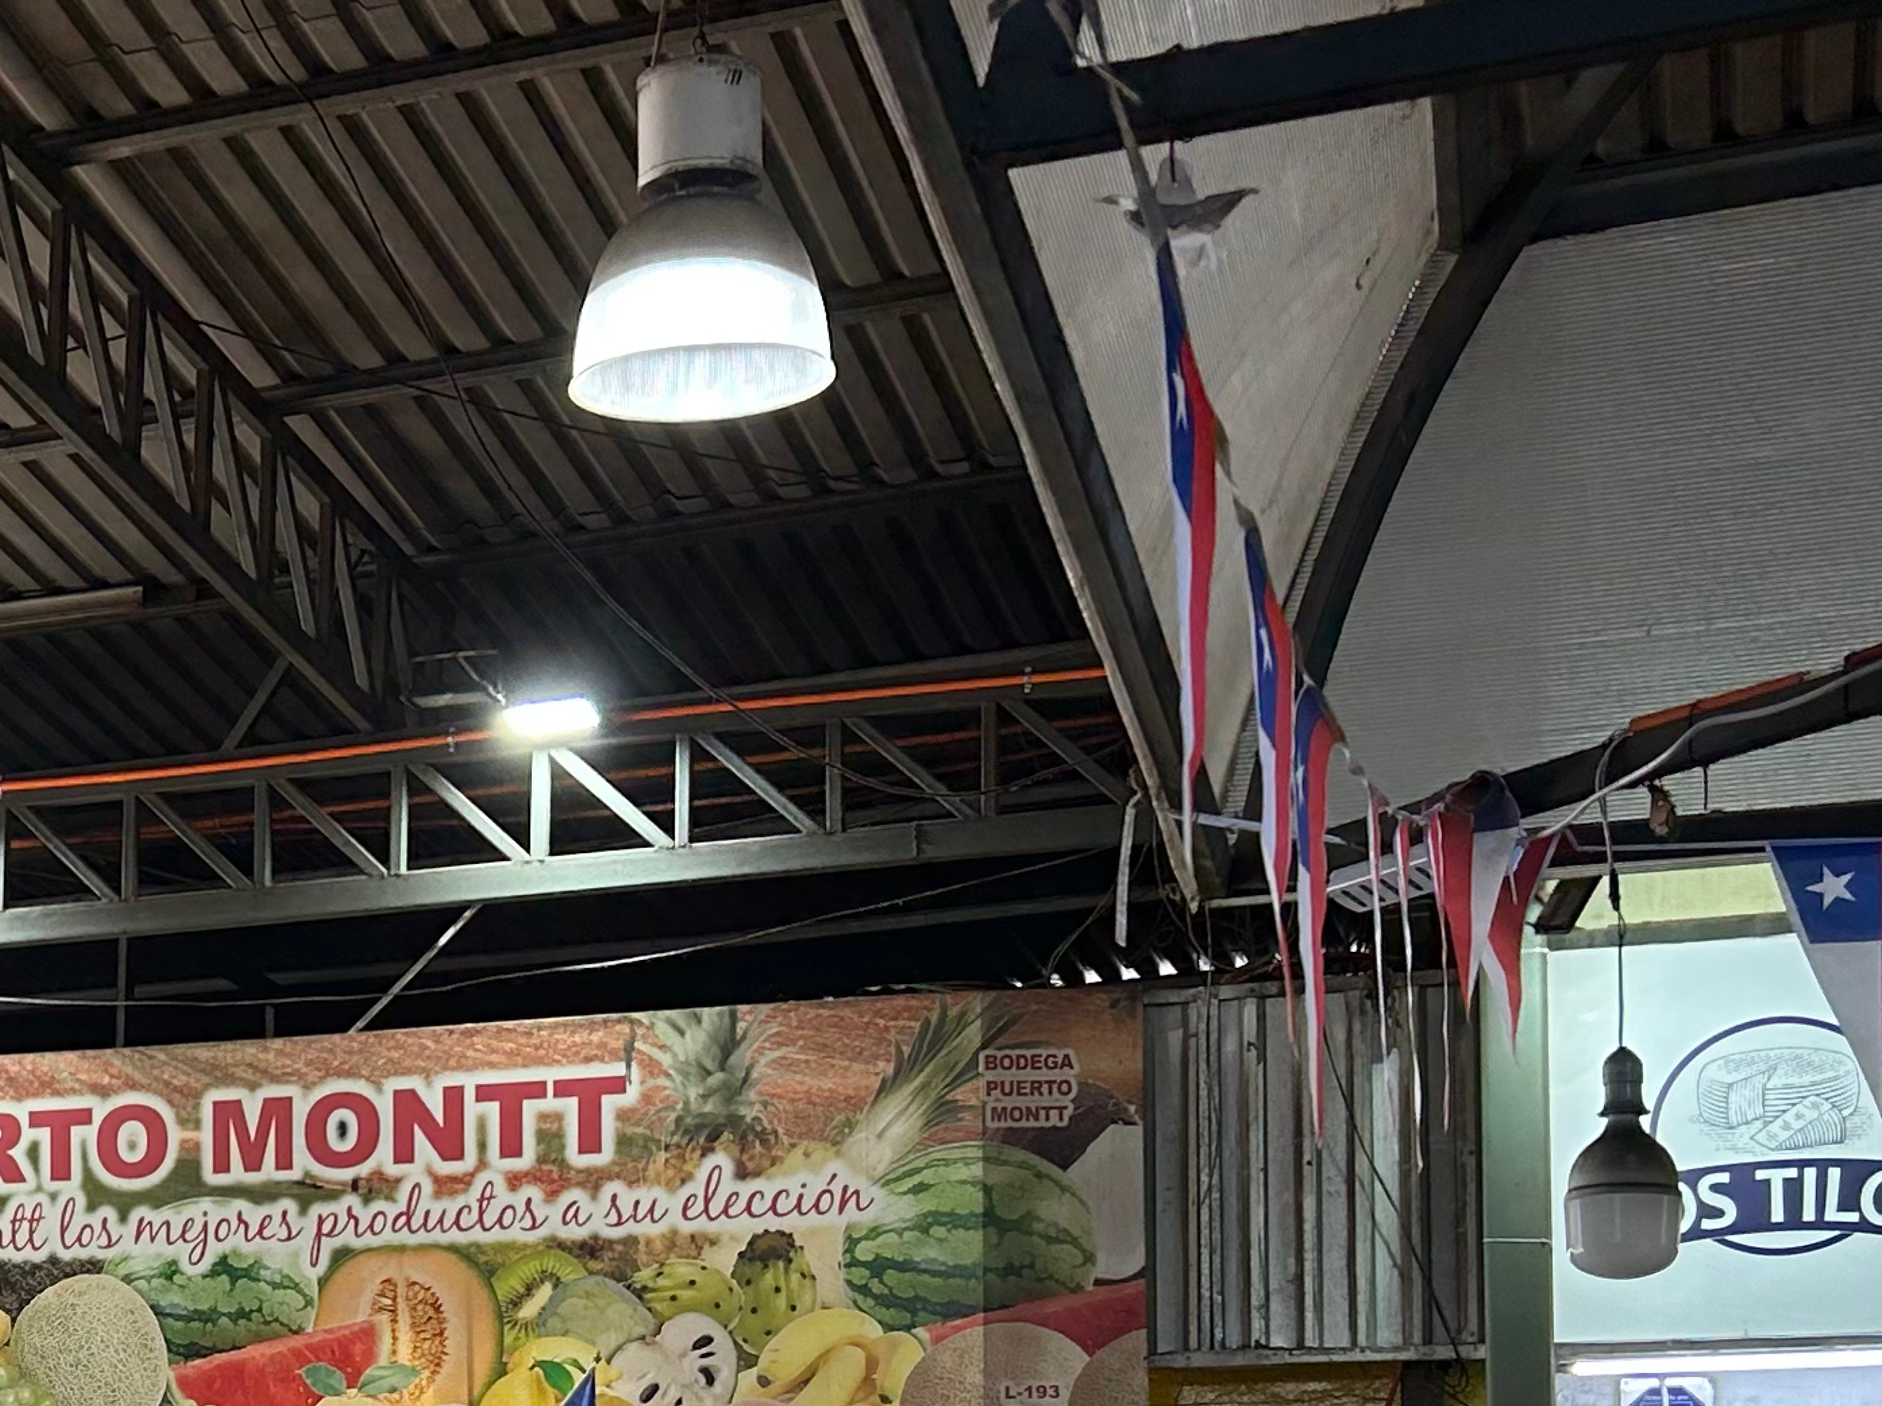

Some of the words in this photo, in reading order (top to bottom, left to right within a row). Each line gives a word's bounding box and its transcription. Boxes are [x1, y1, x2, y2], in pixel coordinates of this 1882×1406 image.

[984, 1053, 1075, 1071] BODEGA
[985, 1079, 1072, 1097] PUERTO
[990, 1105, 1068, 1122] MONTT
[212, 1074, 627, 1174] MONTT
[60, 1197, 123, 1251] los
[134, 1207, 303, 1265] mejores
[309, 1180, 550, 1268] productos
[561, 1200, 593, 1226] a
[603, 1192, 668, 1228] su
[680, 1164, 875, 1222] elección
[1004, 1384, 1060, 1399] L-193
